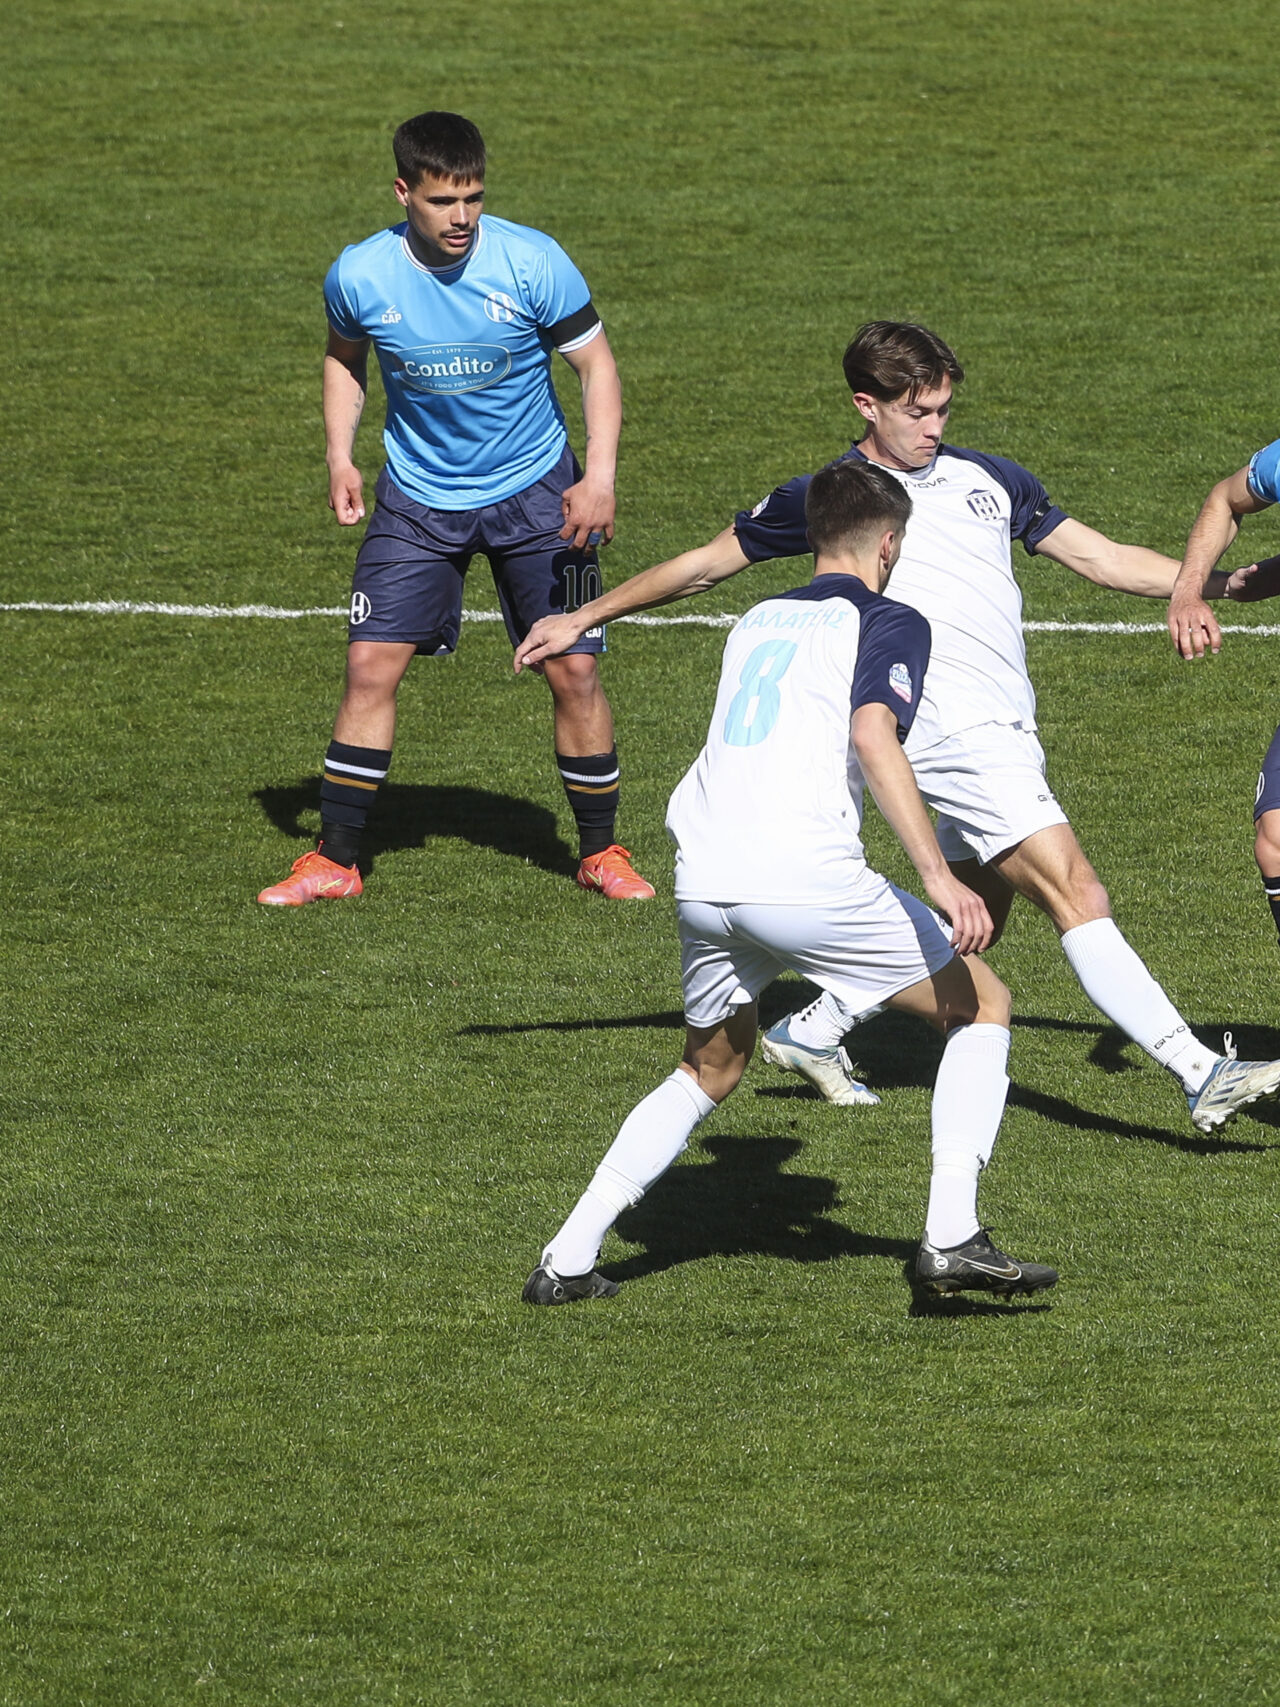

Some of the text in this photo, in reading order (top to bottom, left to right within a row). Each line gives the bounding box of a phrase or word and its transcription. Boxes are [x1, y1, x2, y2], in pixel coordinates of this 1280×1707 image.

[381, 313, 402, 324] CAP
[404, 356, 494, 377] Condito
[563, 564, 601, 615] 10
[723, 639, 798, 748] 8
